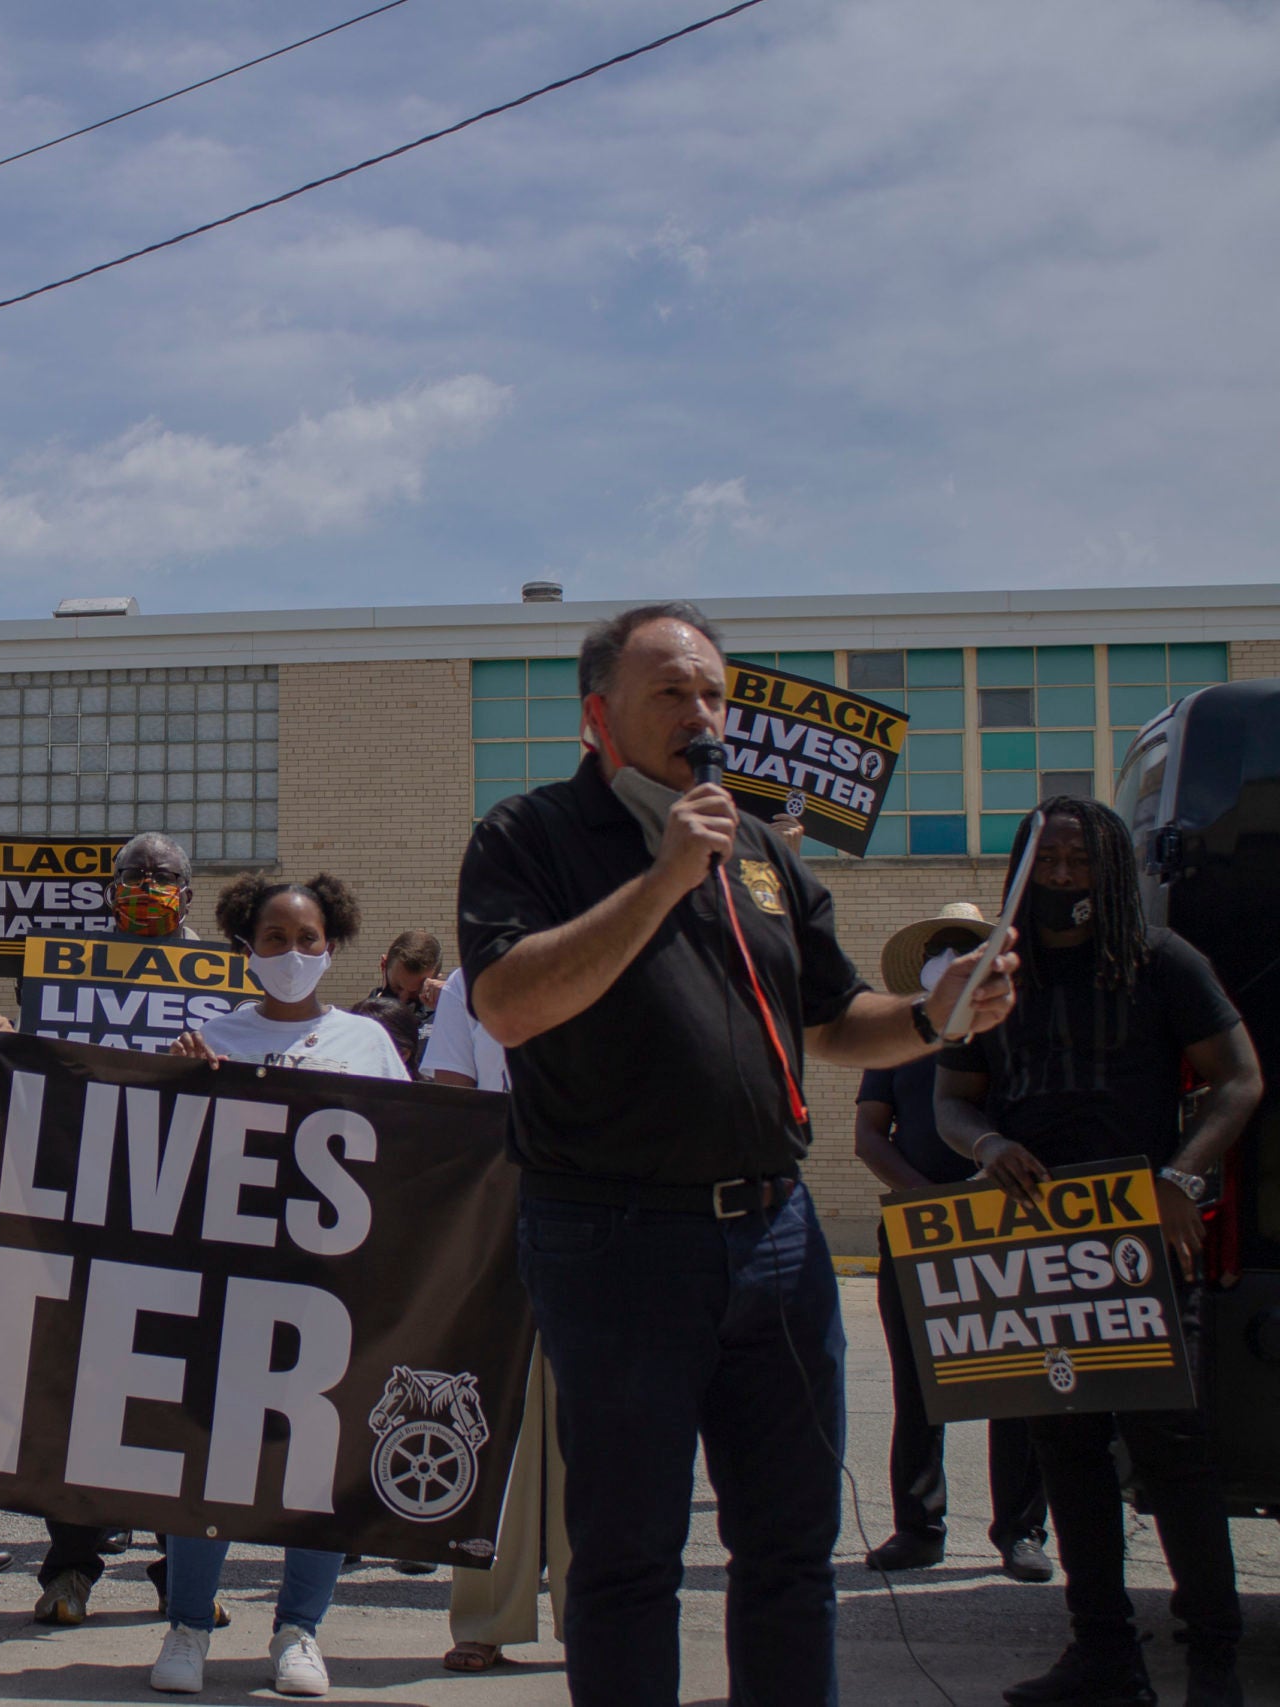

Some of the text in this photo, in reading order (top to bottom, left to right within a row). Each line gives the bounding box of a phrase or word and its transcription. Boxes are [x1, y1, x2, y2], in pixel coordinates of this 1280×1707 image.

[723, 706, 862, 772] LIVES
[732, 671, 898, 748] BLACK
[723, 743, 877, 814] MATTER
[40, 984, 232, 1031] LIVES
[903, 1176, 1144, 1250] BLACK
[916, 1240, 1116, 1307] LIVES
[925, 1297, 1168, 1357] MATTER
[404, 1423, 456, 1441] Brotherhood
